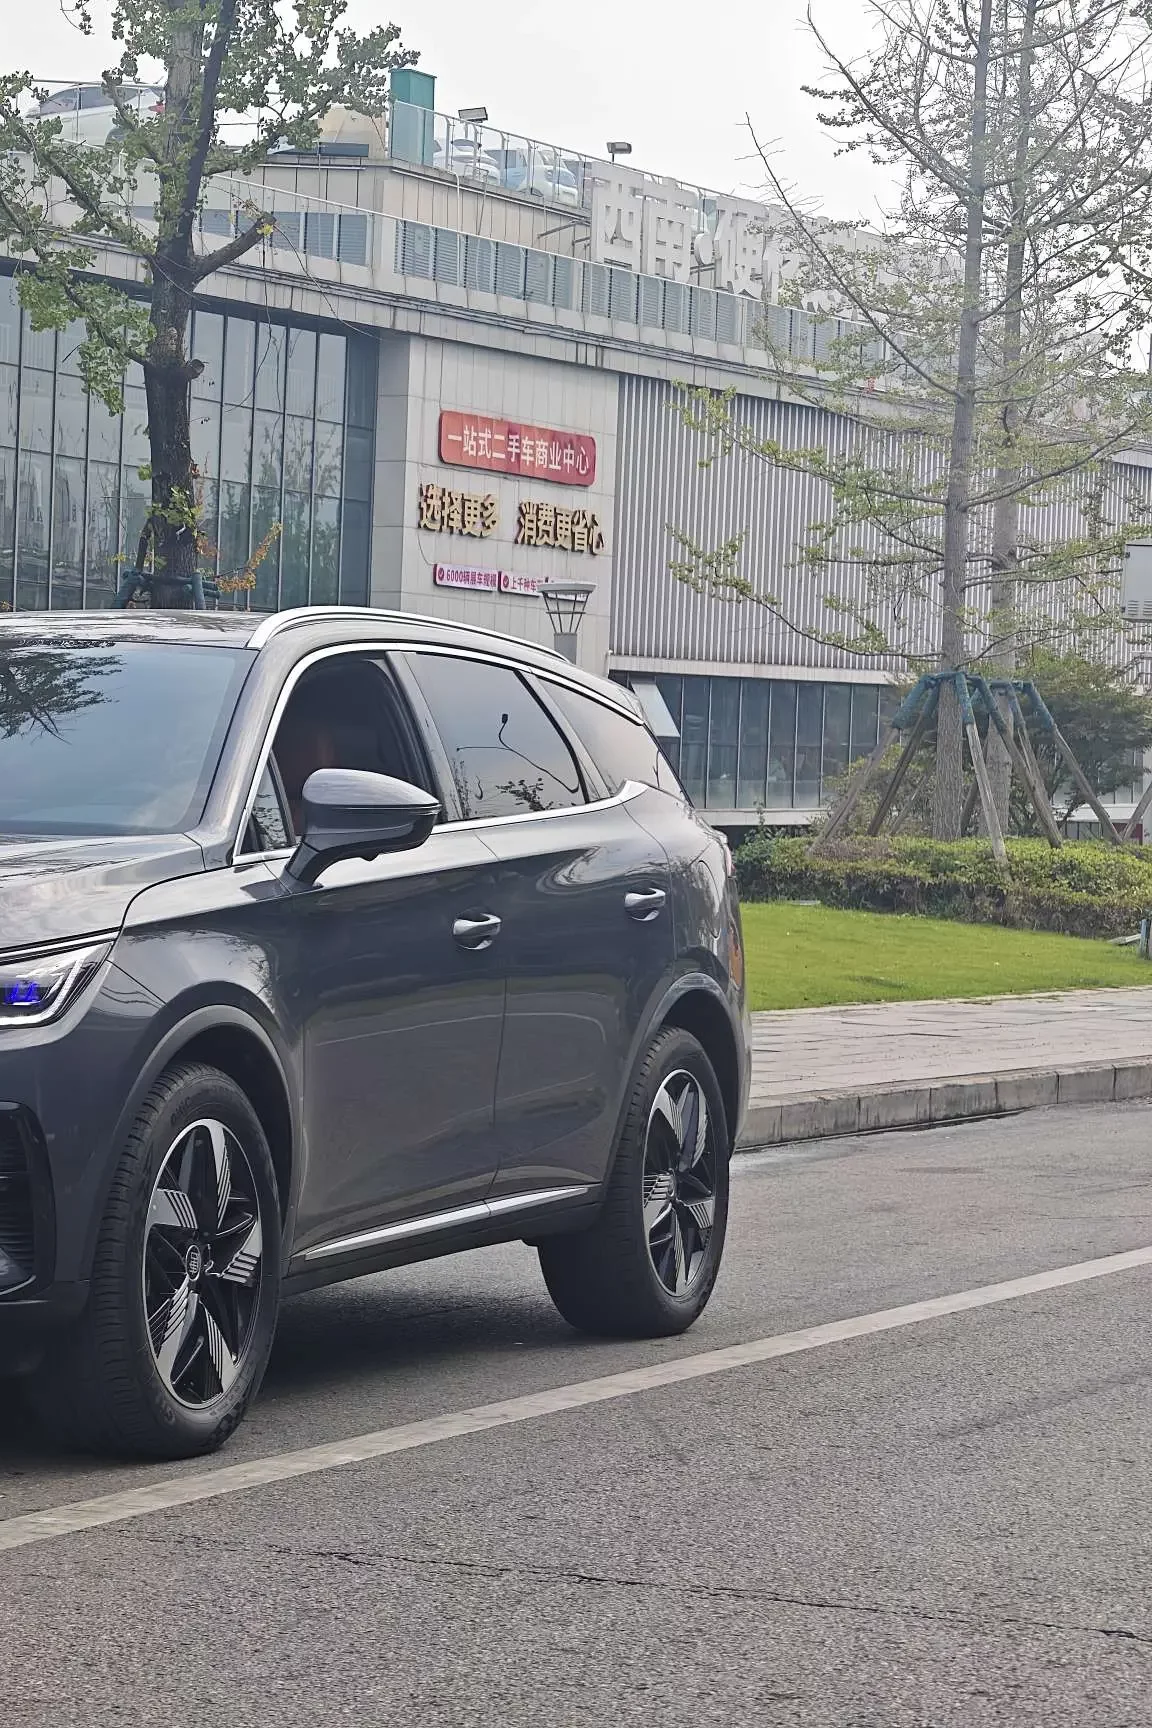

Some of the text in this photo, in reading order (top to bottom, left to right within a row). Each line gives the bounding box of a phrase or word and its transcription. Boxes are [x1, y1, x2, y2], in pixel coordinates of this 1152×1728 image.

[447, 424, 589, 475] 一站式二手车商业中心
[419, 482, 605, 555] 选择更多 消费更省心
